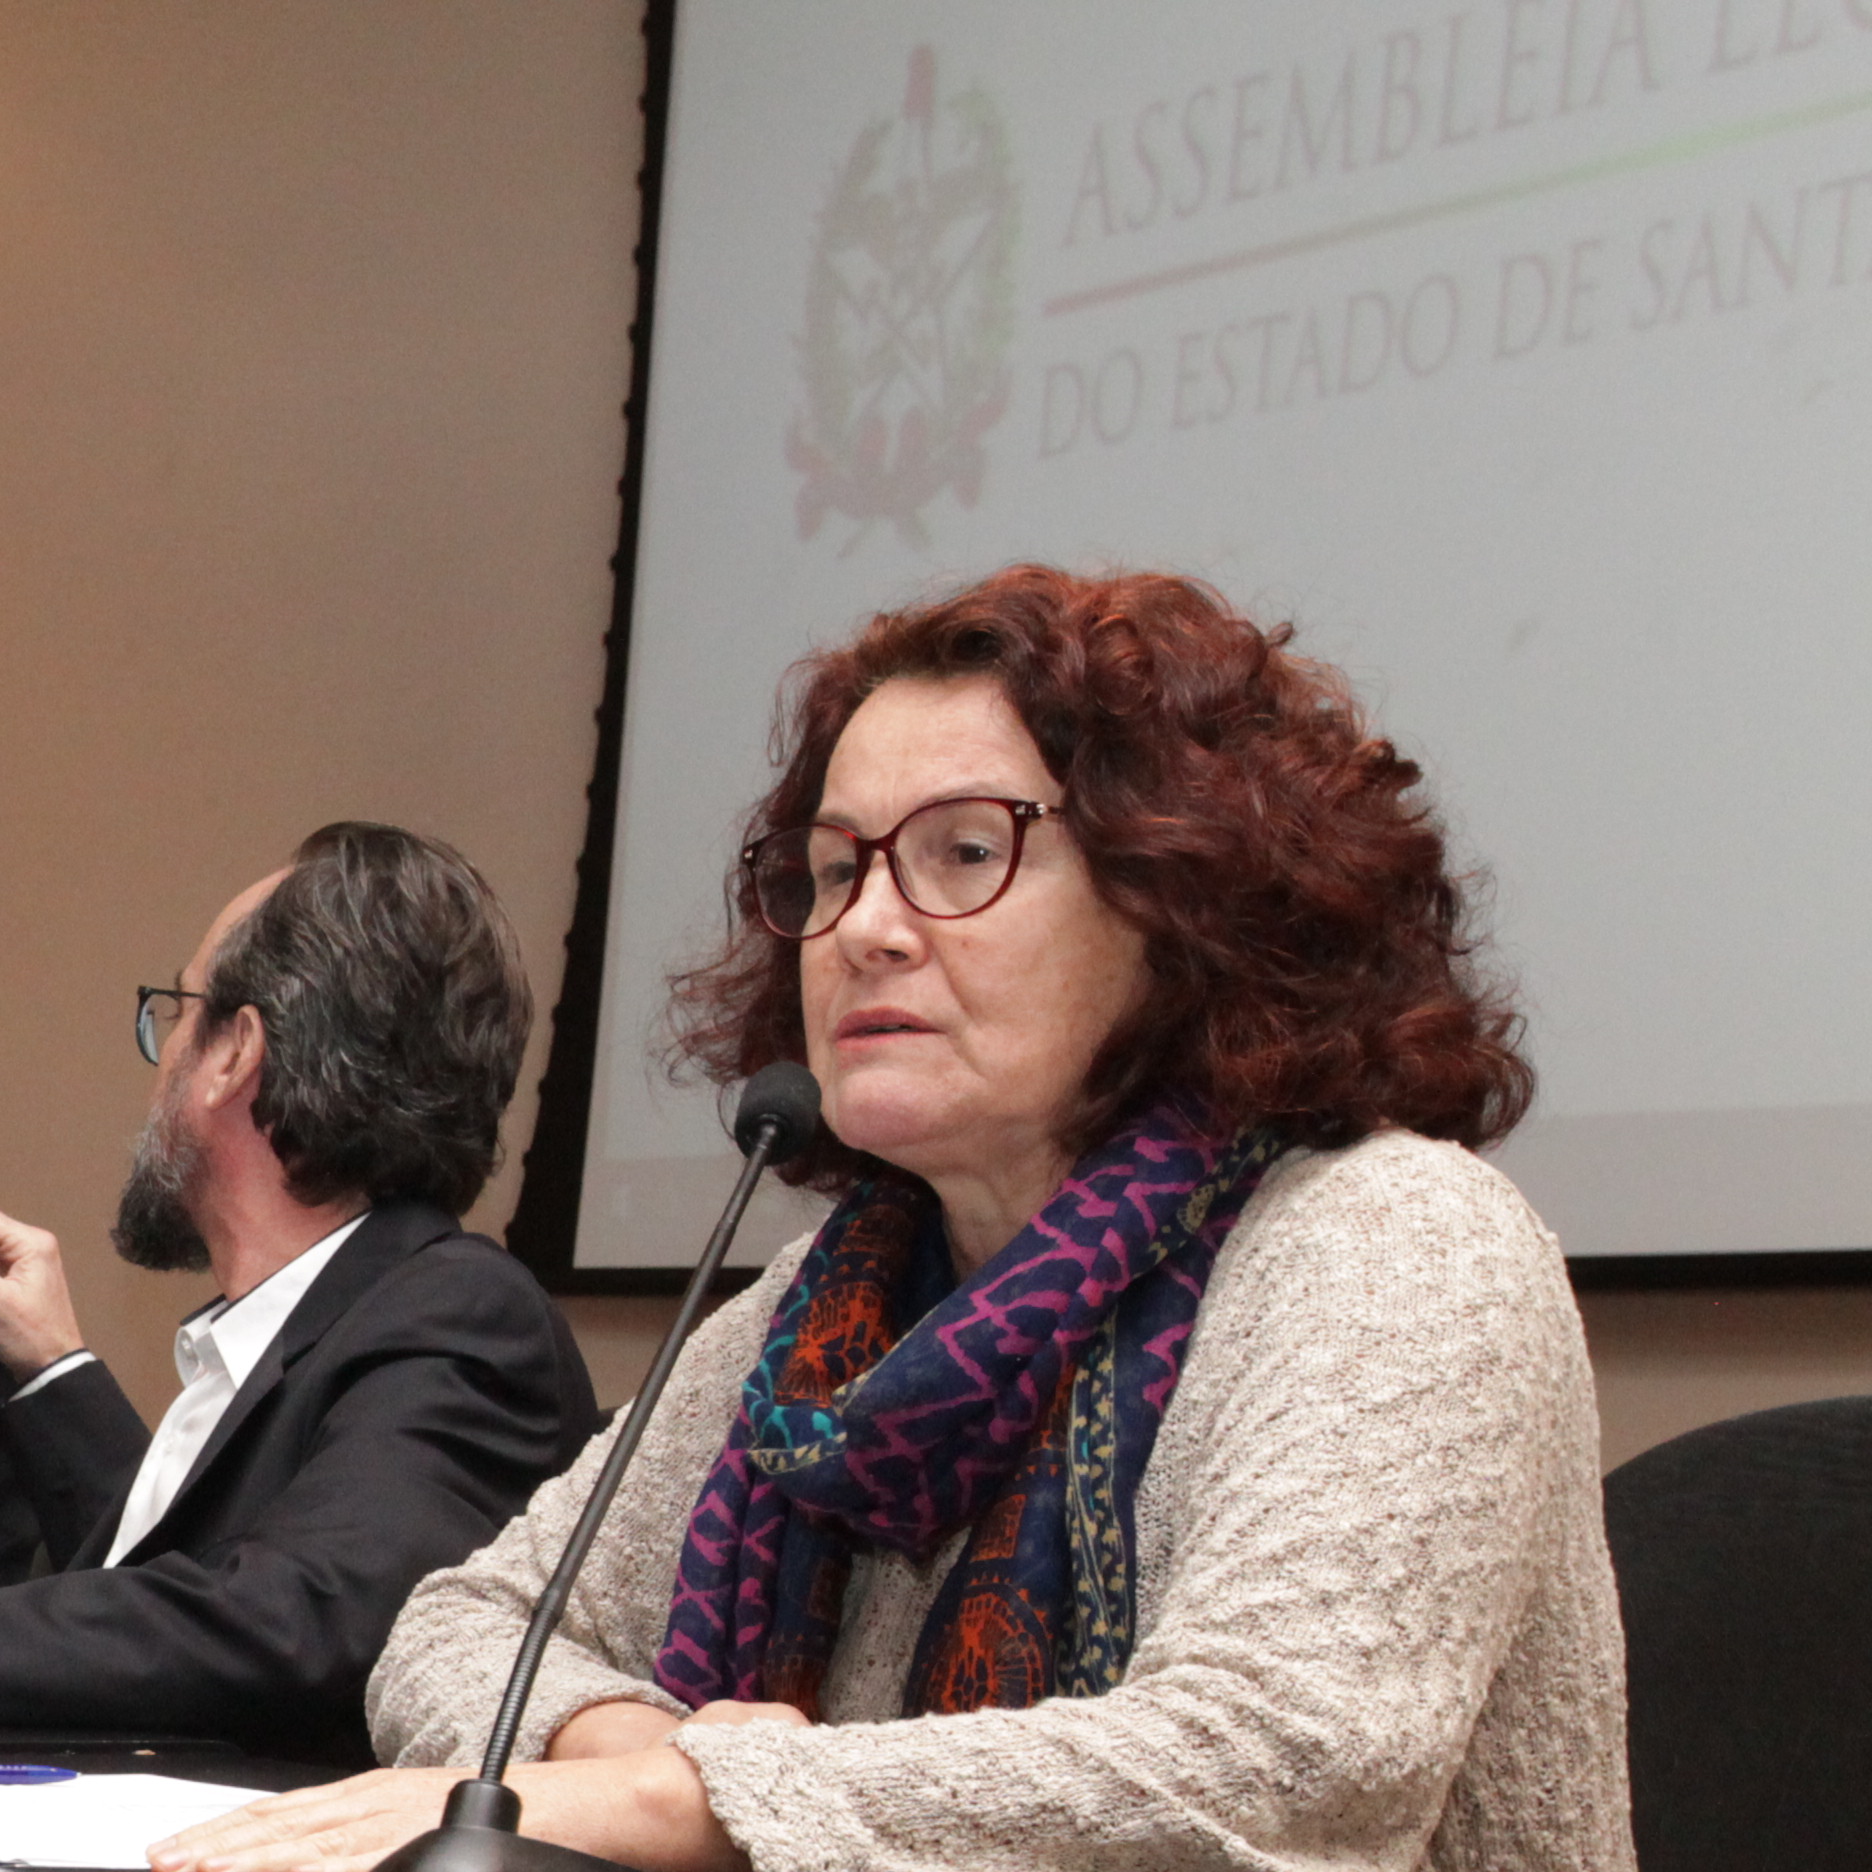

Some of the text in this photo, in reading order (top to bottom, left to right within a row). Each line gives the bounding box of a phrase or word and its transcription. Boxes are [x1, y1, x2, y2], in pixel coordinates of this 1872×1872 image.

[1036, 172, 1872, 461] DO ESTADO DE SANT
